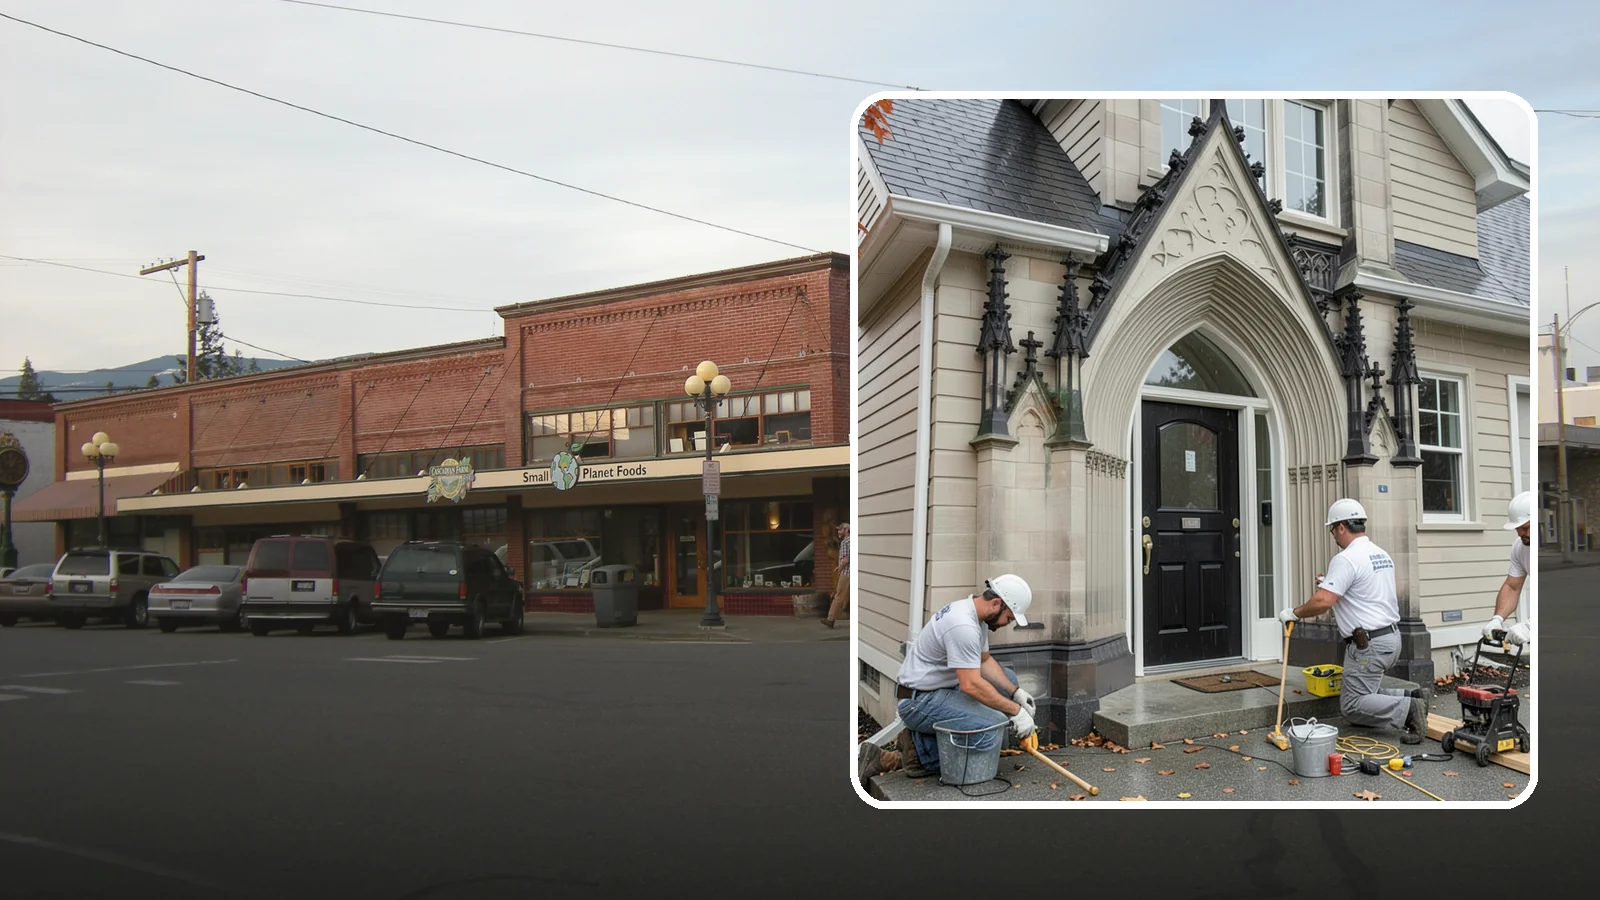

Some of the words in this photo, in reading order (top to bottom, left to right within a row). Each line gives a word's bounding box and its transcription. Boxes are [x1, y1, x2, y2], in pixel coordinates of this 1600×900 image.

[523, 471, 549, 483] Small
[583, 467, 614, 480] Planet
[617, 464, 647, 477] Foods
